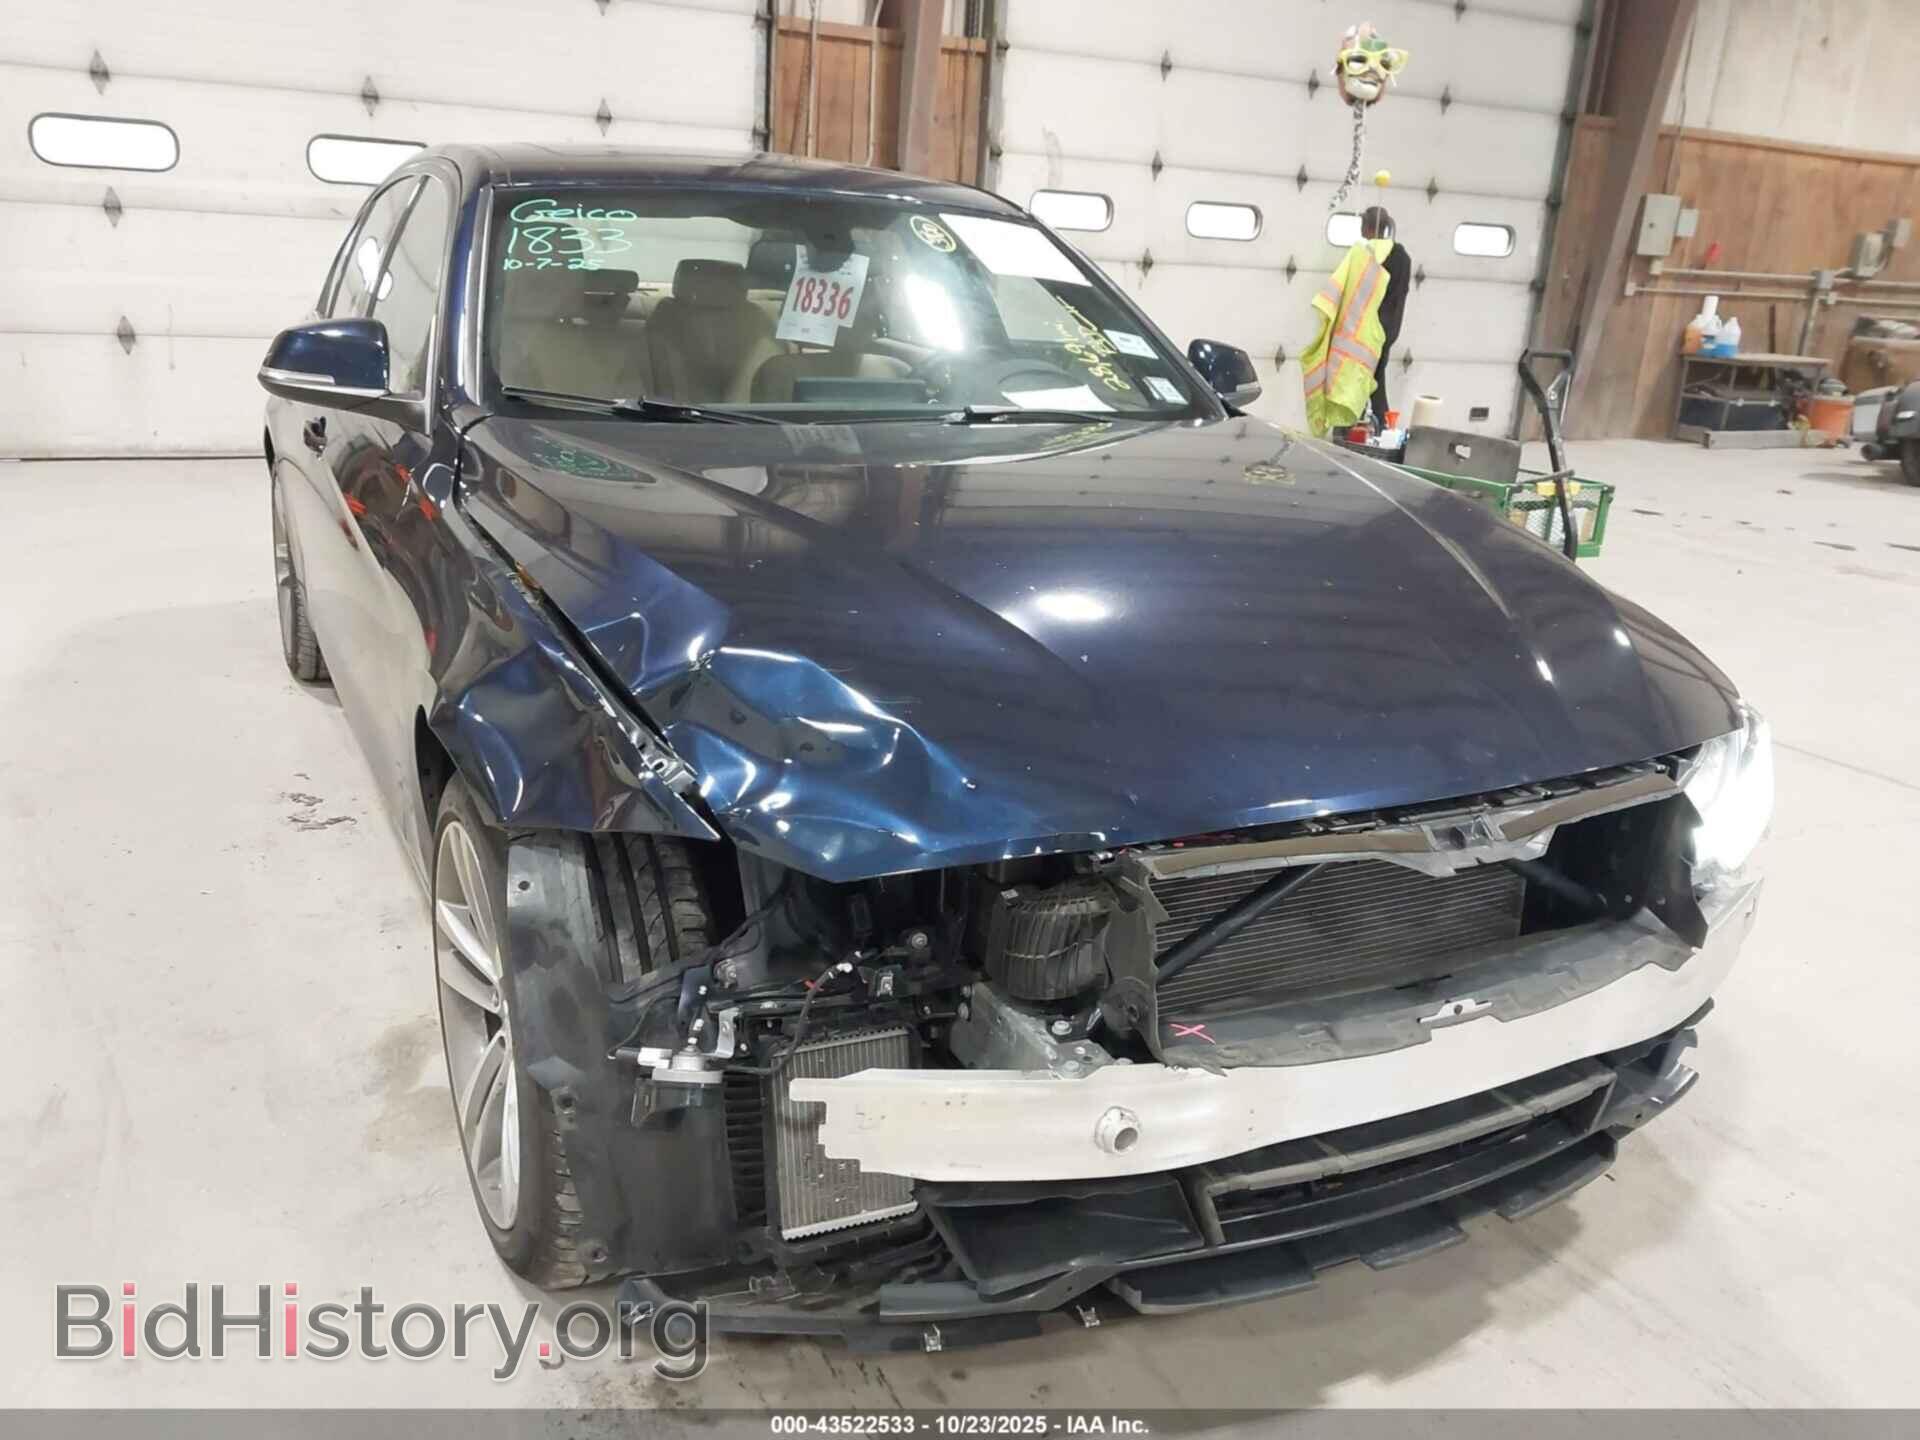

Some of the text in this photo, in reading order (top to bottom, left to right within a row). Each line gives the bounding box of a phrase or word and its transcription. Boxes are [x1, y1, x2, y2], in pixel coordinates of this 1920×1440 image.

[510, 198, 638, 223] Geico
[506, 226, 633, 255] 1833
[792, 276, 855, 320] 18336
